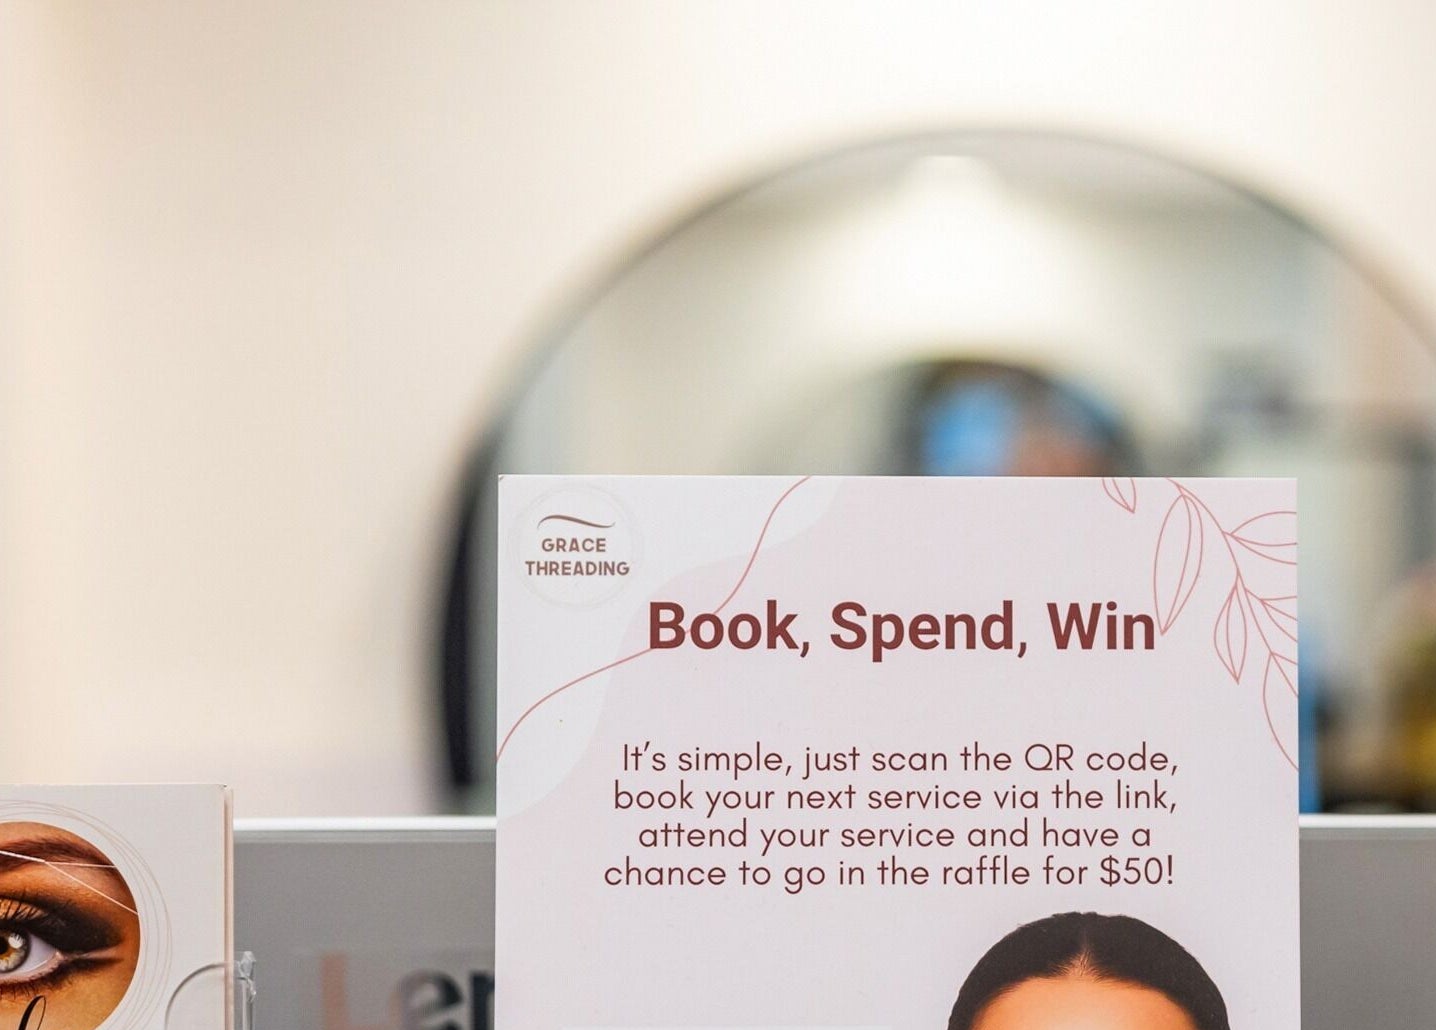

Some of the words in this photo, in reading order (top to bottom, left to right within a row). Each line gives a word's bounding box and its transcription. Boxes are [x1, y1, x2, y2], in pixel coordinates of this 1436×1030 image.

[541, 537, 607, 553] GRACE
[525, 560, 630, 576] THREADING
[649, 599, 810, 658] Book,
[830, 599, 1027, 663] Spend,
[1046, 600, 1155, 650] Win
[678, 740, 792, 780] simple,
[802, 744, 861, 780] just
[871, 752, 948, 772] scan
[959, 740, 1012, 772] the
[1024, 743, 1074, 772] QR
[1086, 740, 1178, 778] code,
[614, 778, 694, 810] book
[705, 790, 776, 818] your
[787, 784, 857, 810] next
[867, 784, 982, 810] service
[993, 783, 1040, 810] via
[1051, 778, 1104, 810] the
[1117, 778, 1177, 814] link,
[638, 817, 747, 848] attend
[759, 829, 830, 857] your
[840, 822, 955, 848] service
[967, 817, 1029, 848] and
[1042, 817, 1120, 848] have
[1131, 828, 1151, 848] a
[604, 855, 727, 886] chance
[738, 860, 772, 886] to
[784, 866, 826, 895] go
[839, 860, 865, 886] in
[876, 854, 930, 886] the
[942, 854, 1031, 886] raffle
[1042, 854, 1089, 886] for
[1099, 854, 1173, 889] $50!
